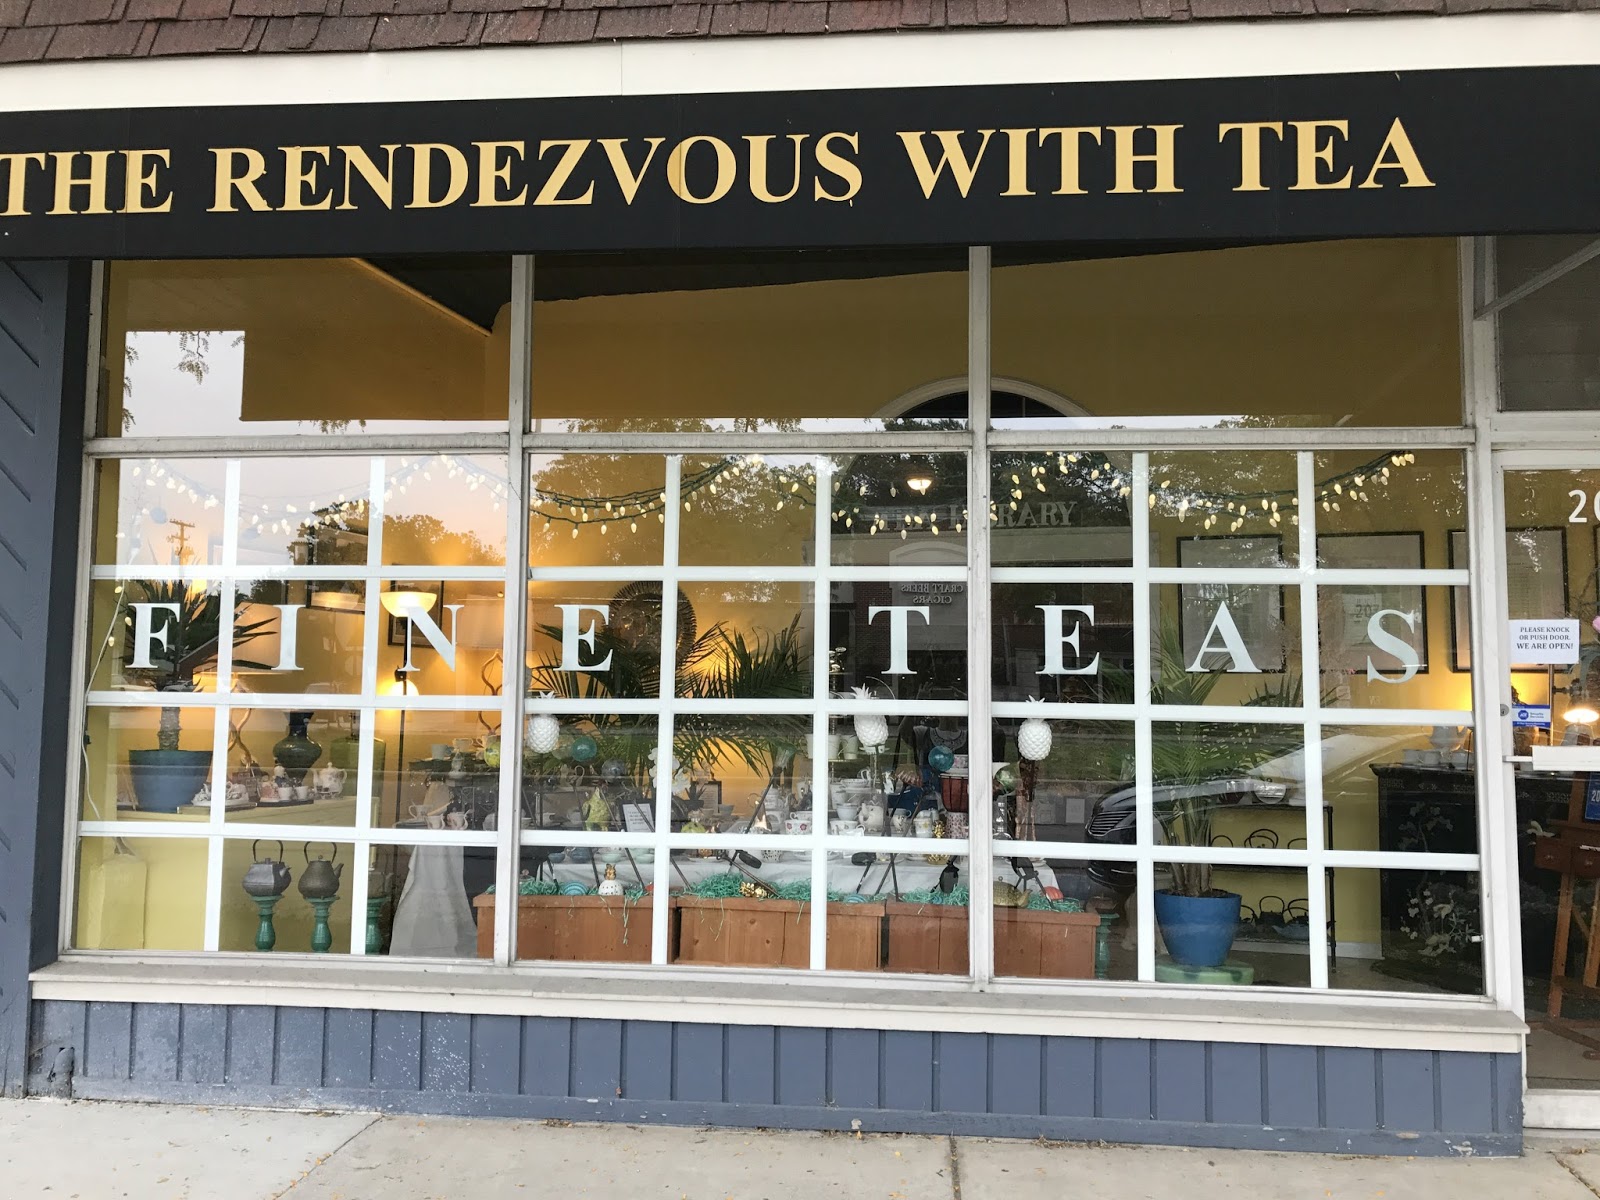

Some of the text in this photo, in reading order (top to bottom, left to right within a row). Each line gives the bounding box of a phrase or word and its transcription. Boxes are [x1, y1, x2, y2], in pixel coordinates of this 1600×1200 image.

[0, 116, 1436, 216] THE RENDEZVOUS WITH TEA
[125, 601, 1420, 684] FINE TEAS
[1531, 642, 1547, 650] ARE
[1548, 642, 1574, 650] OPEN!
